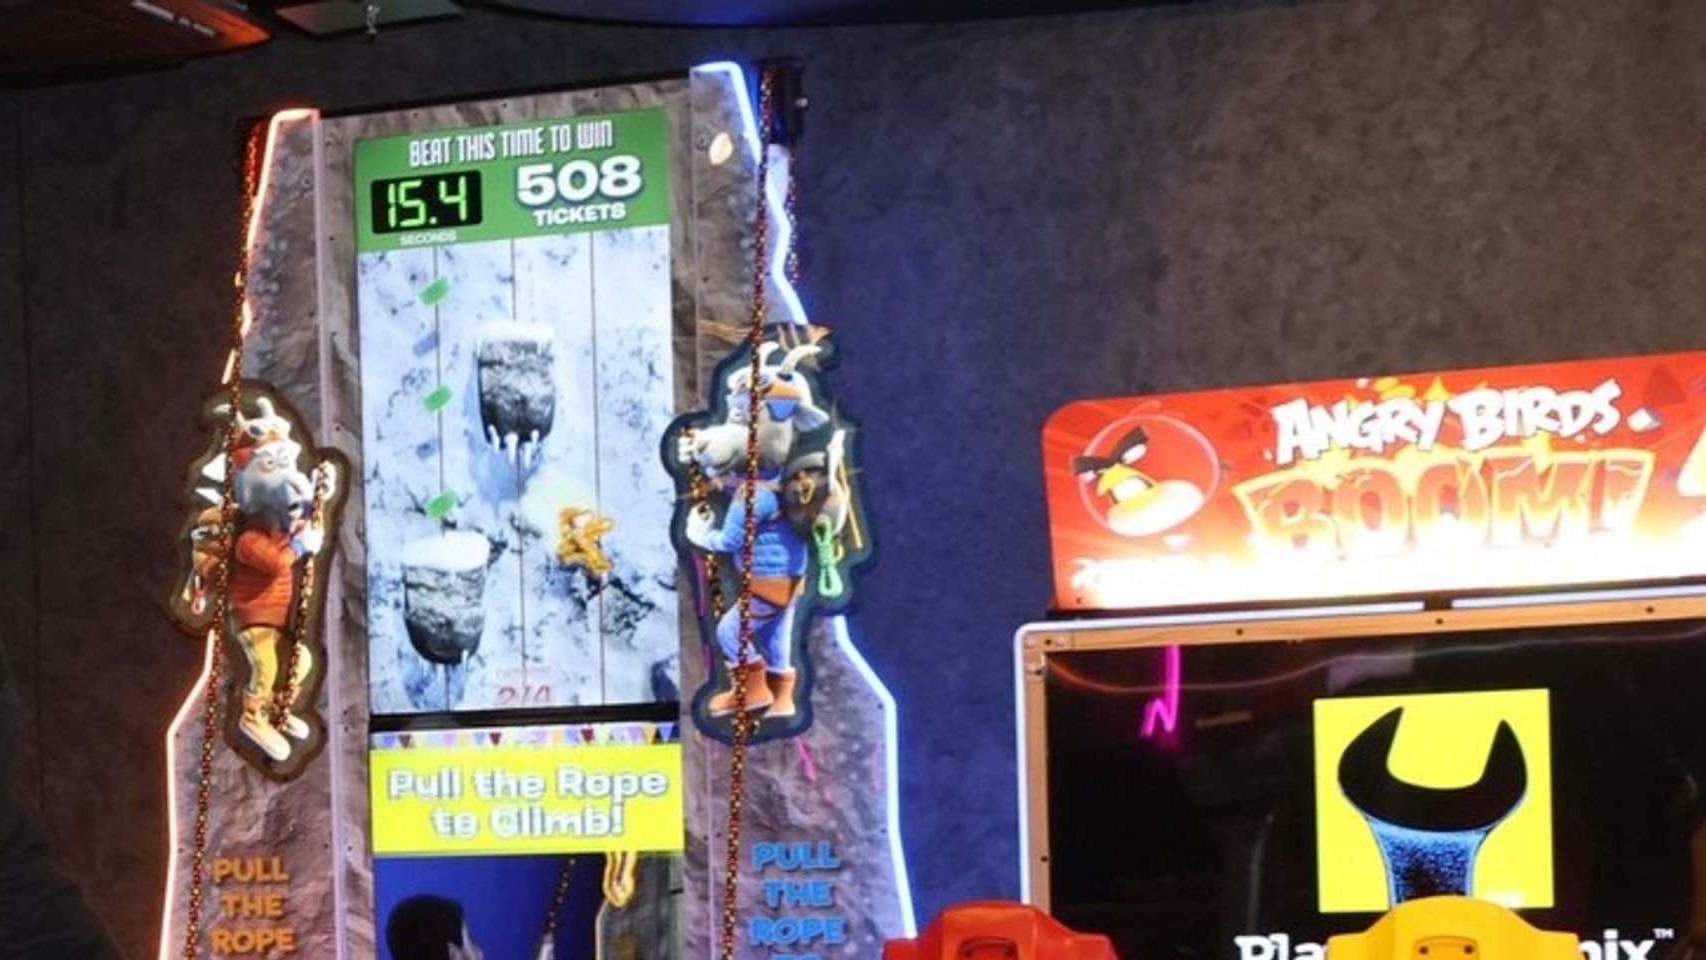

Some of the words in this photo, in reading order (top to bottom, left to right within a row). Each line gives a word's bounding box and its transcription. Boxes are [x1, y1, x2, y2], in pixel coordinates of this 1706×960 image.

[409, 137, 450, 168] BEAT
[457, 133, 495, 163] THIS
[502, 128, 543, 158] TIME
[551, 125, 571, 153] TO
[577, 120, 613, 150] WIN
[516, 155, 643, 206] 508
[387, 175, 468, 228] 15.4
[533, 202, 626, 227] TICKETS
[399, 230, 458, 246] SECONDS
[1269, 395, 1446, 464] ANGRY
[1448, 378, 1623, 451] BIRDS
[388, 766, 462, 800] Pull
[474, 767, 546, 799] the
[556, 763, 669, 806] Rope
[432, 808, 479, 837] to
[489, 802, 625, 839] Climb!
[212, 855, 289, 884] PULL
[751, 841, 841, 871] PULL
[220, 892, 284, 919] THE
[761, 878, 833, 907] THE
[209, 926, 297, 954] ROPE
[748, 916, 846, 946] ROPE
